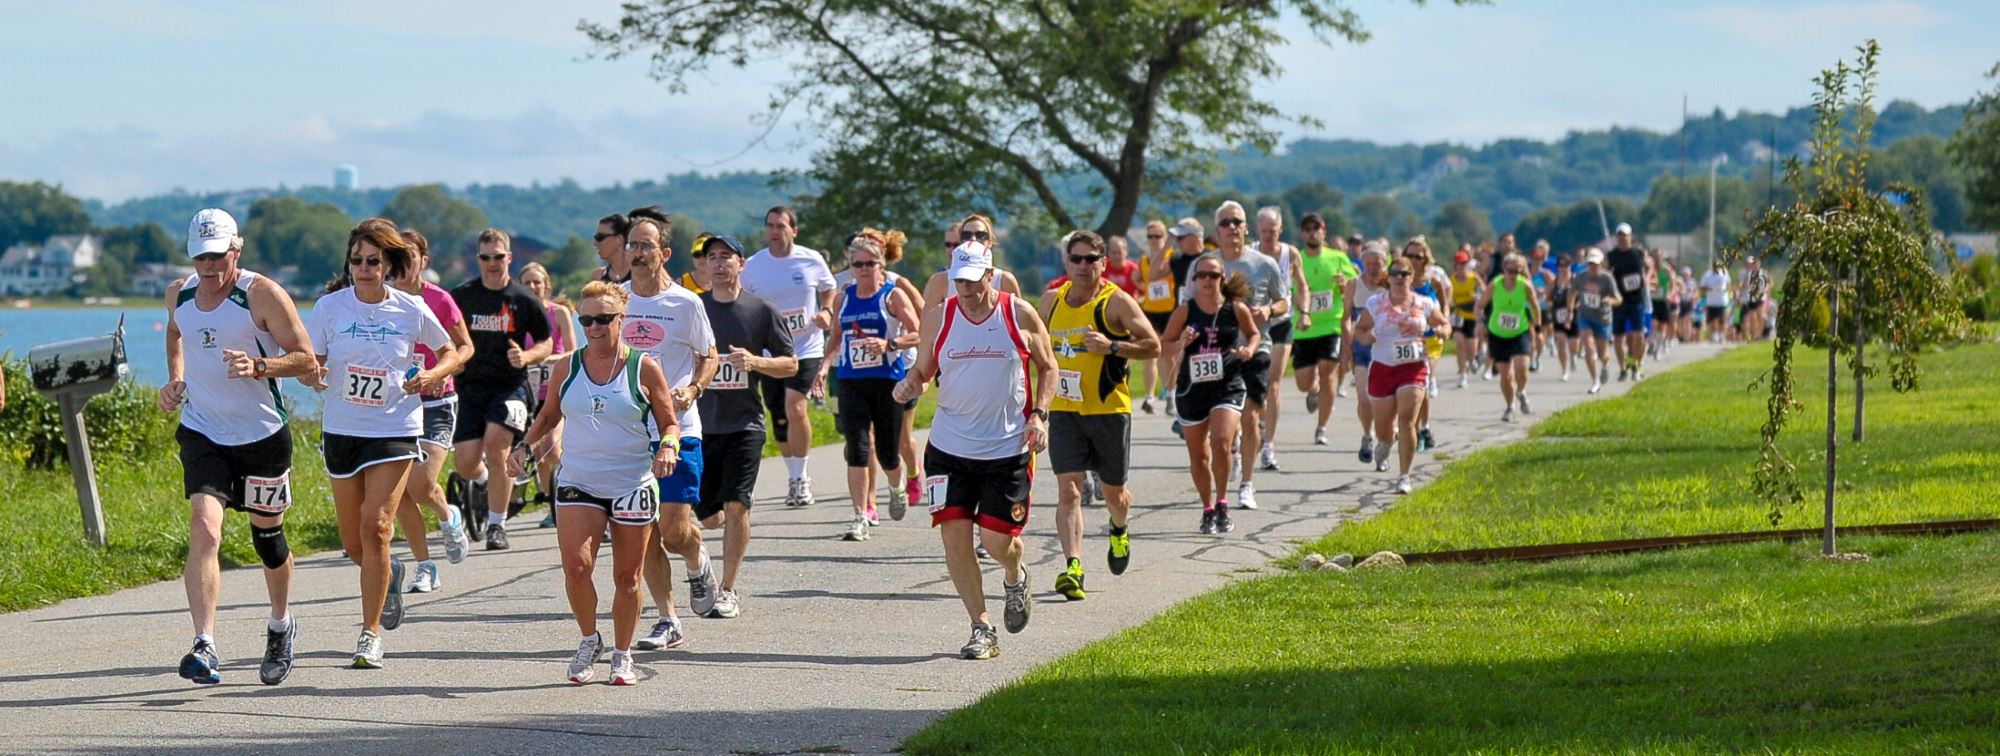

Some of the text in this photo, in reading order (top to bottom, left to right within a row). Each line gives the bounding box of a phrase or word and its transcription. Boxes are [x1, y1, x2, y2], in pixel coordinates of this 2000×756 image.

[1194, 360, 1218, 377] 338
[348, 373, 383, 400] 372
[252, 483, 287, 506] 174
[613, 488, 650, 511] 278
